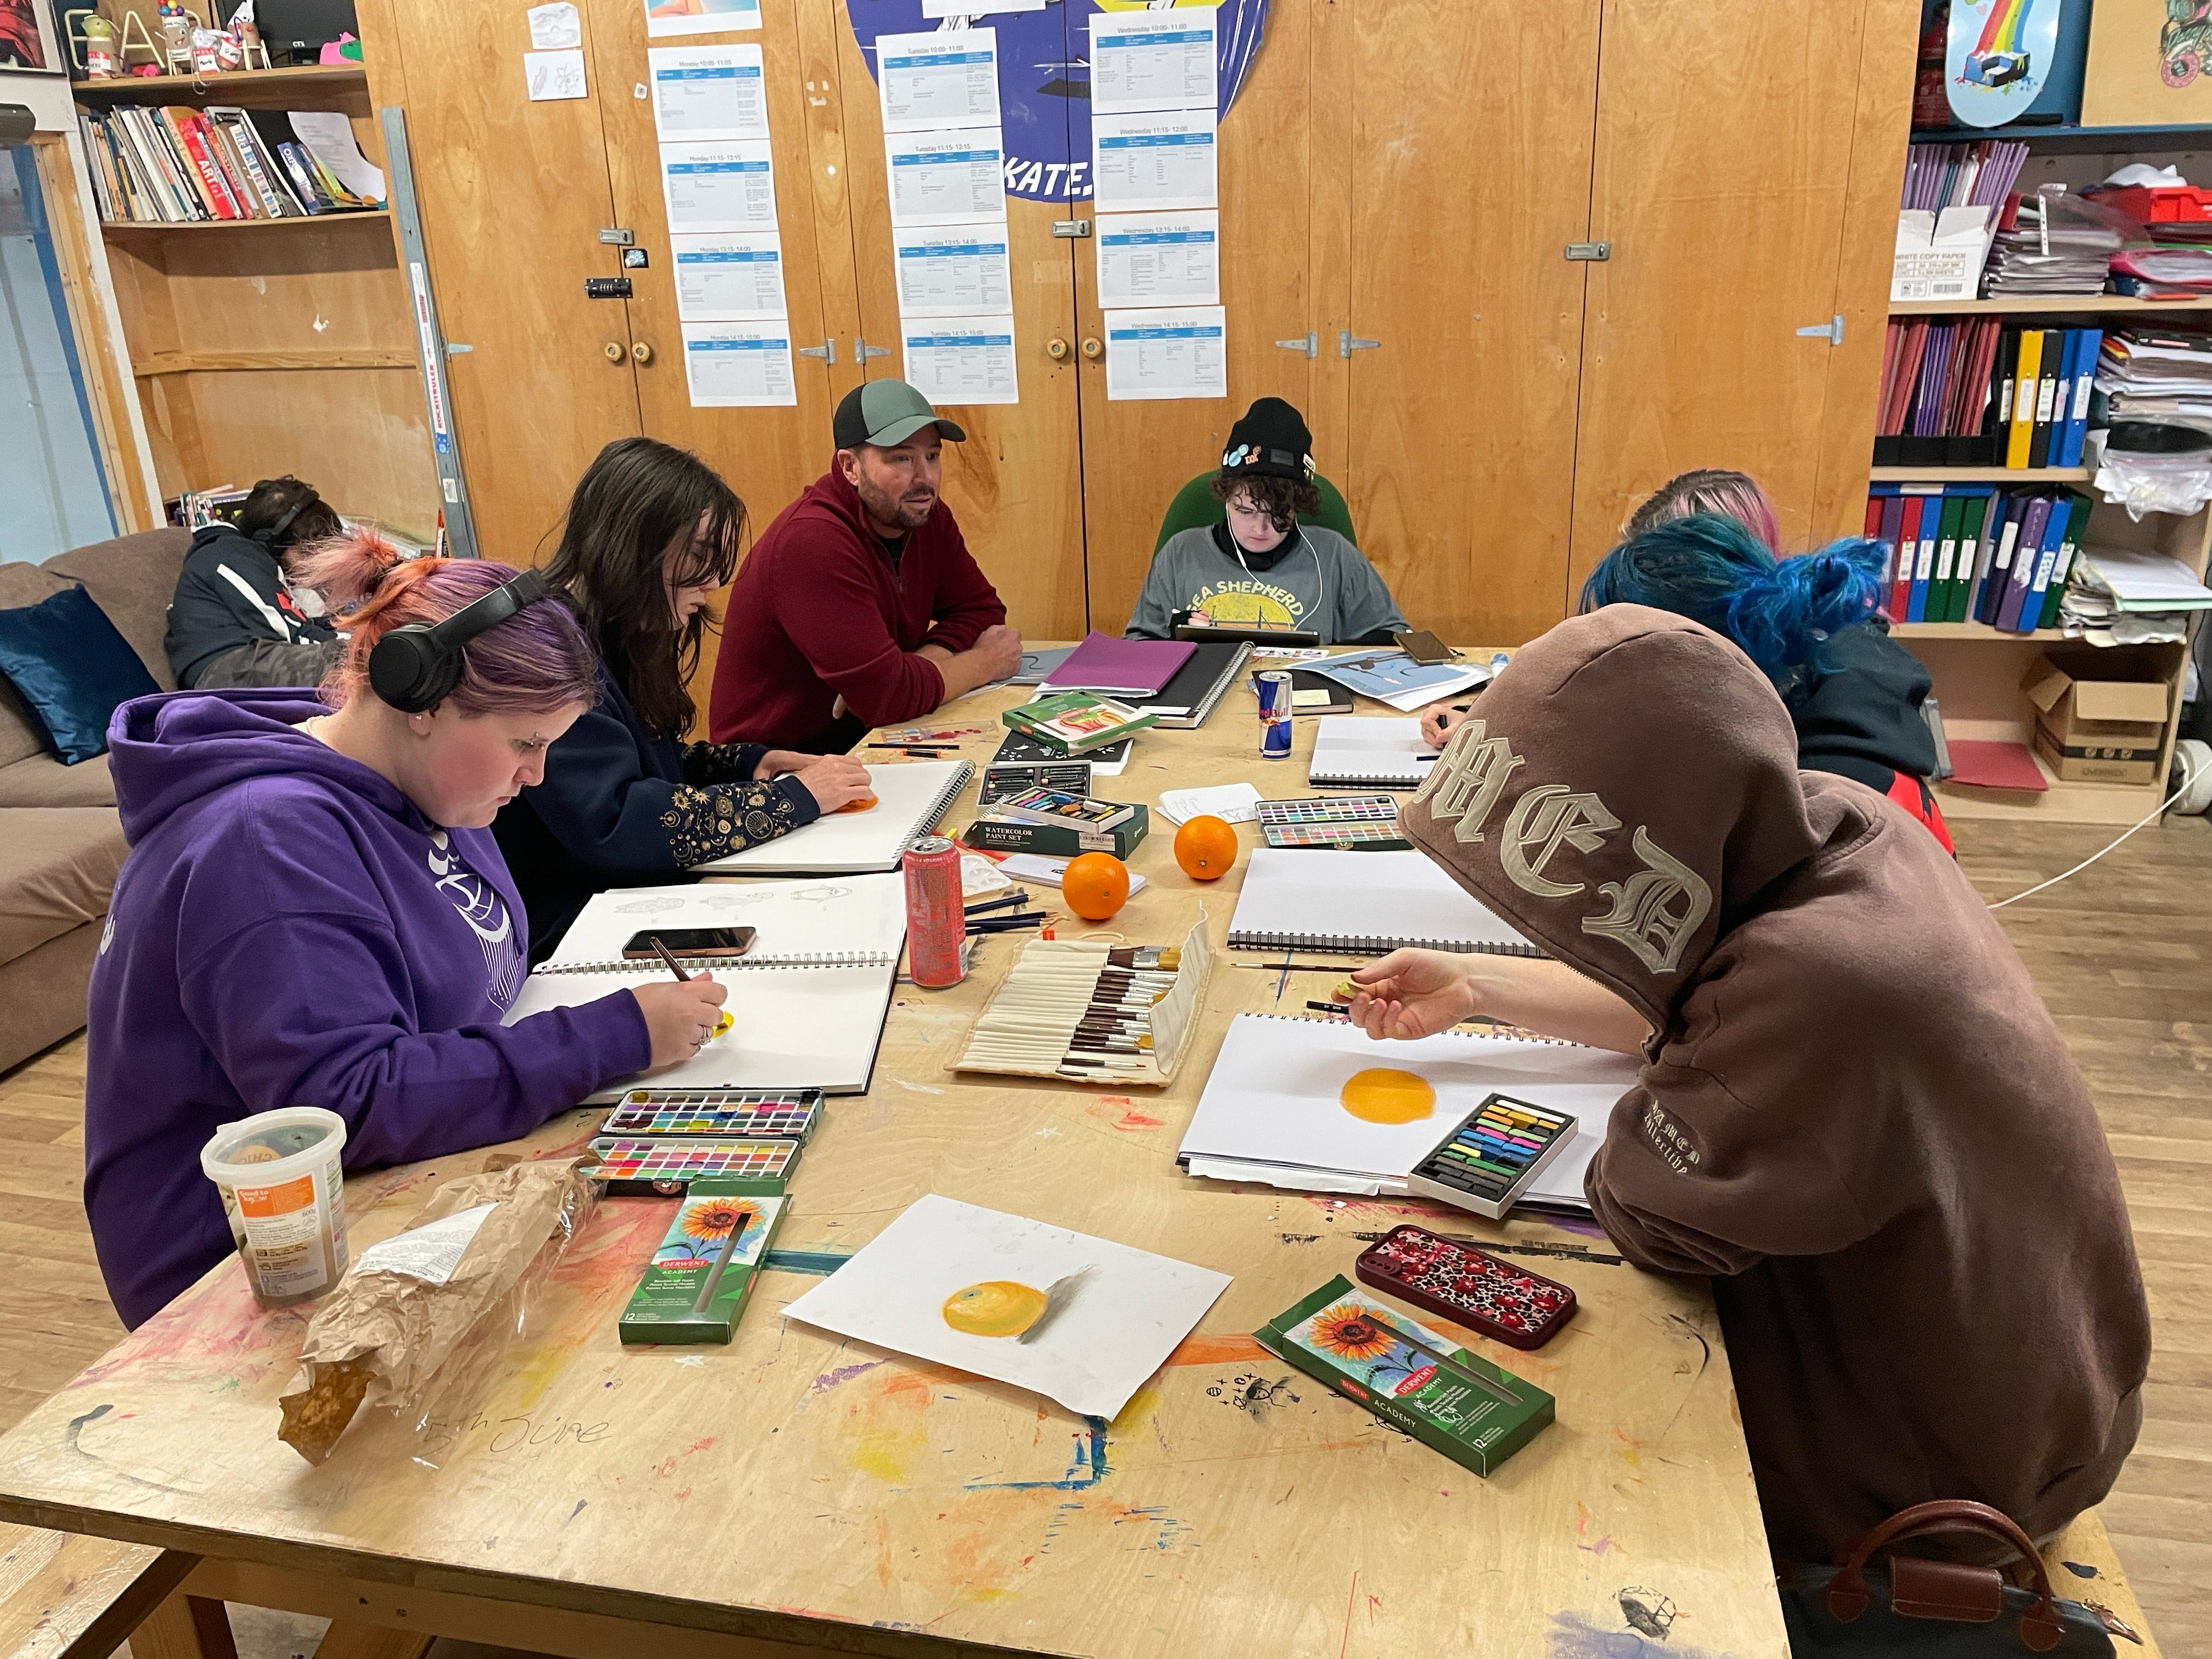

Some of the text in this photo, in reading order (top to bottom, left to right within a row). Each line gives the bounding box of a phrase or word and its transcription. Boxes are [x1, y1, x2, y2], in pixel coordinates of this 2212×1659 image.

[198, 160, 219, 183] ART
[1003, 157, 1093, 196] KATE.
[1216, 580, 1304, 616] SHEPHERD
[1272, 707, 1289, 718] Bull
[985, 827, 1033, 836] WATERCOLOR
[243, 1195, 268, 1204] know
[624, 1312, 636, 1321] 12
[1342, 1379, 1369, 1400] DERWENT
[1399, 1367, 1433, 1394] DERWENT
[1415, 1376, 1443, 1399] ACADEMY
[1374, 1399, 1417, 1428] ACADEMY
[490, 1411, 613, 1453] June
[1472, 1438, 1488, 1449] 12
